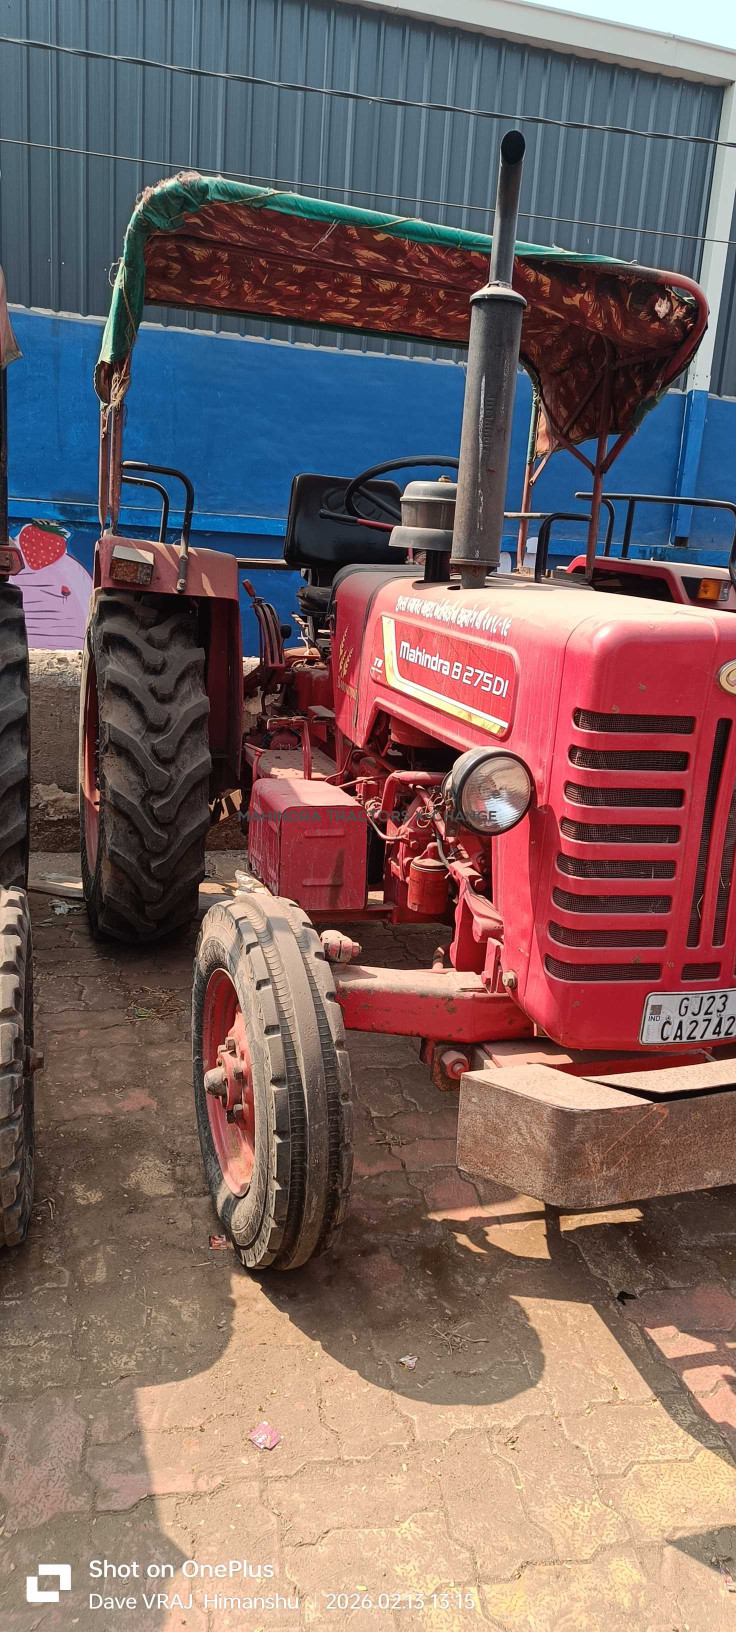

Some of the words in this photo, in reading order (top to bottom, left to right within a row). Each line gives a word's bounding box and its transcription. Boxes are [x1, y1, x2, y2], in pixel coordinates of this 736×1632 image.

[399, 640, 450, 676] Mahindra
[451, 661, 463, 680] B
[678, 994, 729, 1017] GJ23
[660, 1016, 736, 1041] CA2742
